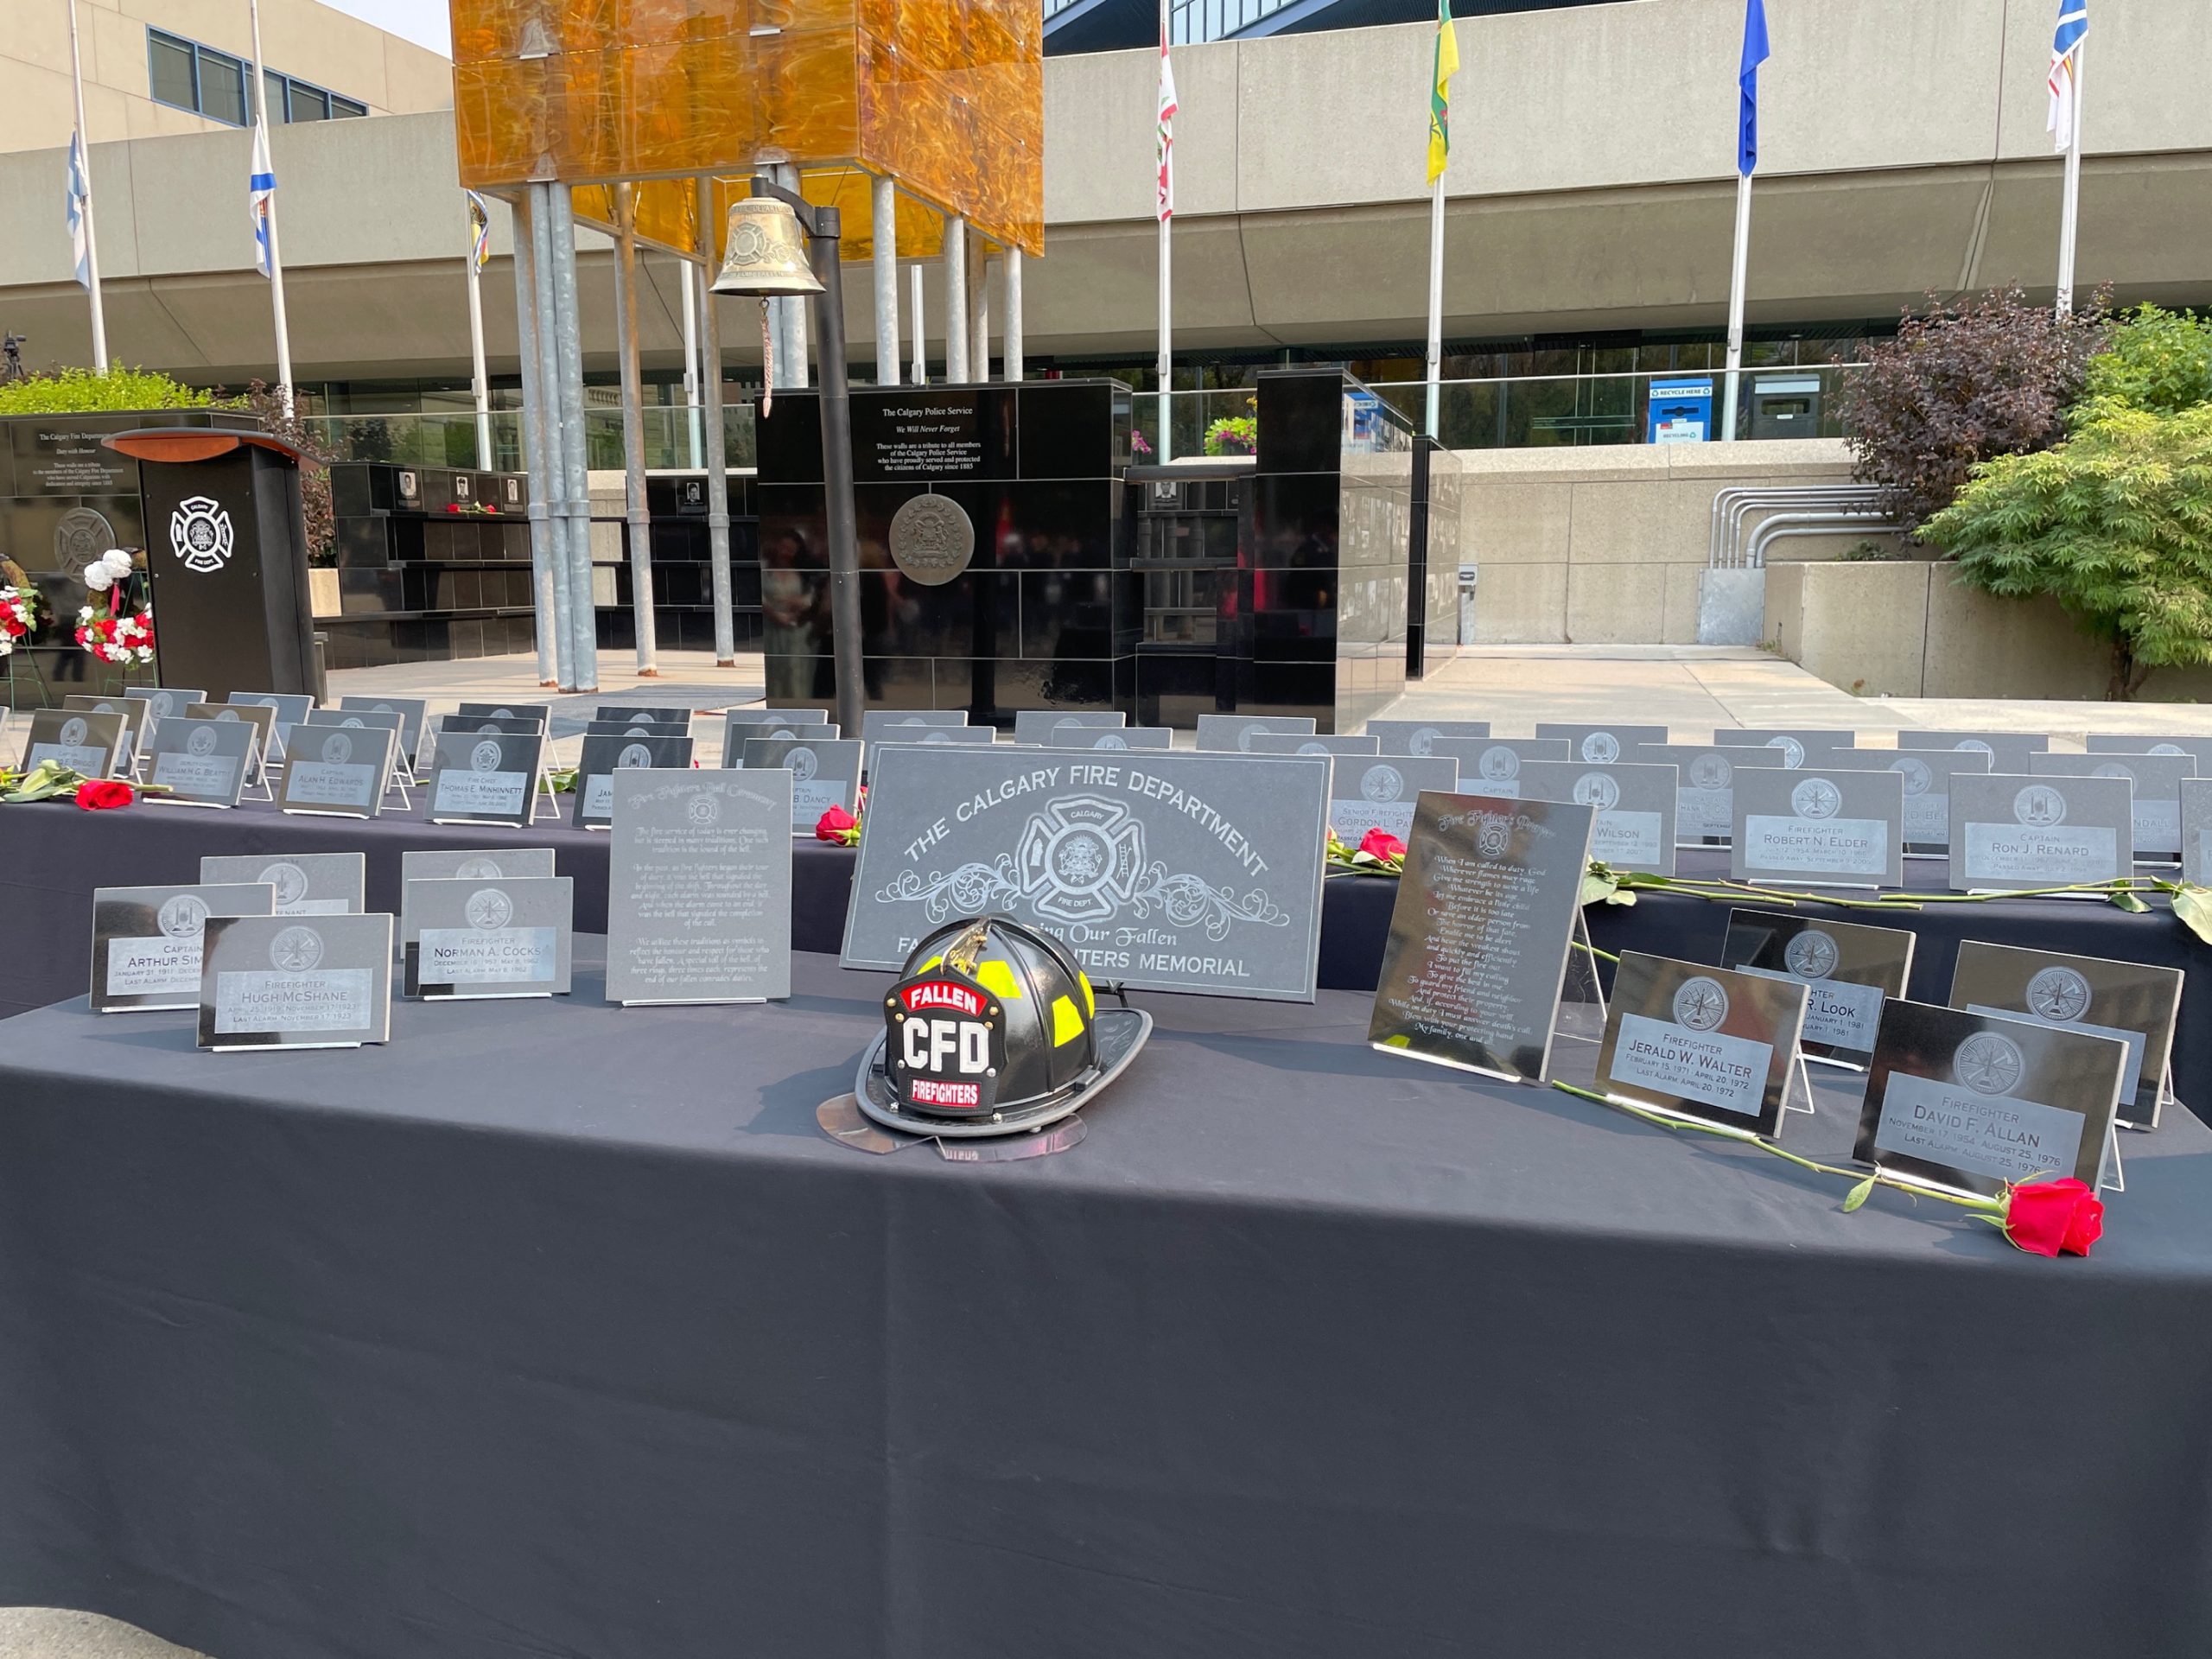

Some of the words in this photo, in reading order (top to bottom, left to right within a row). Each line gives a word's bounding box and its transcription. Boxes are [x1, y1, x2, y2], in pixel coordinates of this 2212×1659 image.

[897, 408, 923, 417] Calgary
[328, 777, 364, 785] EDWARDS
[480, 785, 523, 794] MINHINNETT
[904, 817, 950, 862] THE
[957, 766, 1061, 822] CALGARY
[1070, 765, 1121, 787] FIRE
[1128, 771, 1269, 877] DEPARTMENT
[1071, 810, 1105, 821] CALGARY
[1372, 809, 1414, 817] FIREFIGHTE
[1338, 817, 1380, 827] GORDON
[1438, 814, 1465, 831] Fire
[1789, 825, 1844, 835] FIREFIGHTER
[1597, 828, 1639, 839] WILSON
[1764, 834, 1811, 845] ROBERT
[1830, 837, 1868, 848] ELDER
[2020, 834, 2060, 842] CAPTAIN
[1992, 842, 2018, 854] RON
[2037, 845, 2088, 856] RENARD
[1434, 855, 1456, 864] When
[1477, 861, 1497, 870] called
[1529, 868, 1546, 876] God
[1440, 865, 1476, 876] Wherever
[1502, 875, 1517, 884] may
[1527, 886, 1539, 896] life
[1058, 897, 1072, 906] FIRE
[1070, 925, 1109, 943] Our
[1116, 927, 1177, 947] Fallen
[435, 948, 485, 957] NORMAN
[487, 947, 499, 957] A.
[503, 946, 541, 957] COCKS
[128, 957, 178, 968] ARTHUR
[1139, 953, 1250, 977] MEMORIAL
[242, 992, 279, 1003] HUGH
[910, 985, 978, 1014] FALLEN
[1821, 1001, 1855, 1017] LOOK
[1806, 1014, 1838, 1025] JANUARY
[1848, 1020, 1865, 1029] 1981
[902, 1017, 989, 1074] CFD
[1662, 1033, 1723, 1055] FIREFIGHTER
[1628, 1039, 1675, 1060] JERALD
[1680, 1050, 1694, 1065] W.
[1700, 1054, 1752, 1078] WALTER
[1625, 1053, 1660, 1067] FEBRUARY
[1674, 1065, 1689, 1075] 1971
[1694, 1071, 1714, 1081] APRIL
[1731, 1079, 1749, 1090] 1972
[1637, 1068, 1653, 1077] LAST
[1681, 1079, 1700, 1089] APRIL
[1716, 1086, 1734, 1097] 1972
[912, 1079, 979, 1106] FIREFIGHTERS
[1942, 1096, 2019, 1124] FIREFIGHTER
[1914, 1104, 1961, 1128] DAVID
[1966, 1116, 1979, 1134] F.
[1985, 1122, 2040, 1148] ALLAN
[1889, 1117, 1935, 1135] NOVEMBER
[1953, 1132, 1976, 1145] 1954
[1981, 1141, 2017, 1155] AUGUST
[2037, 1154, 2061, 1166] 1976
[1904, 1133, 1926, 1145] LAST
[1962, 1148, 1998, 1163] AUGUST
[2018, 1161, 2041, 1173] 1976
